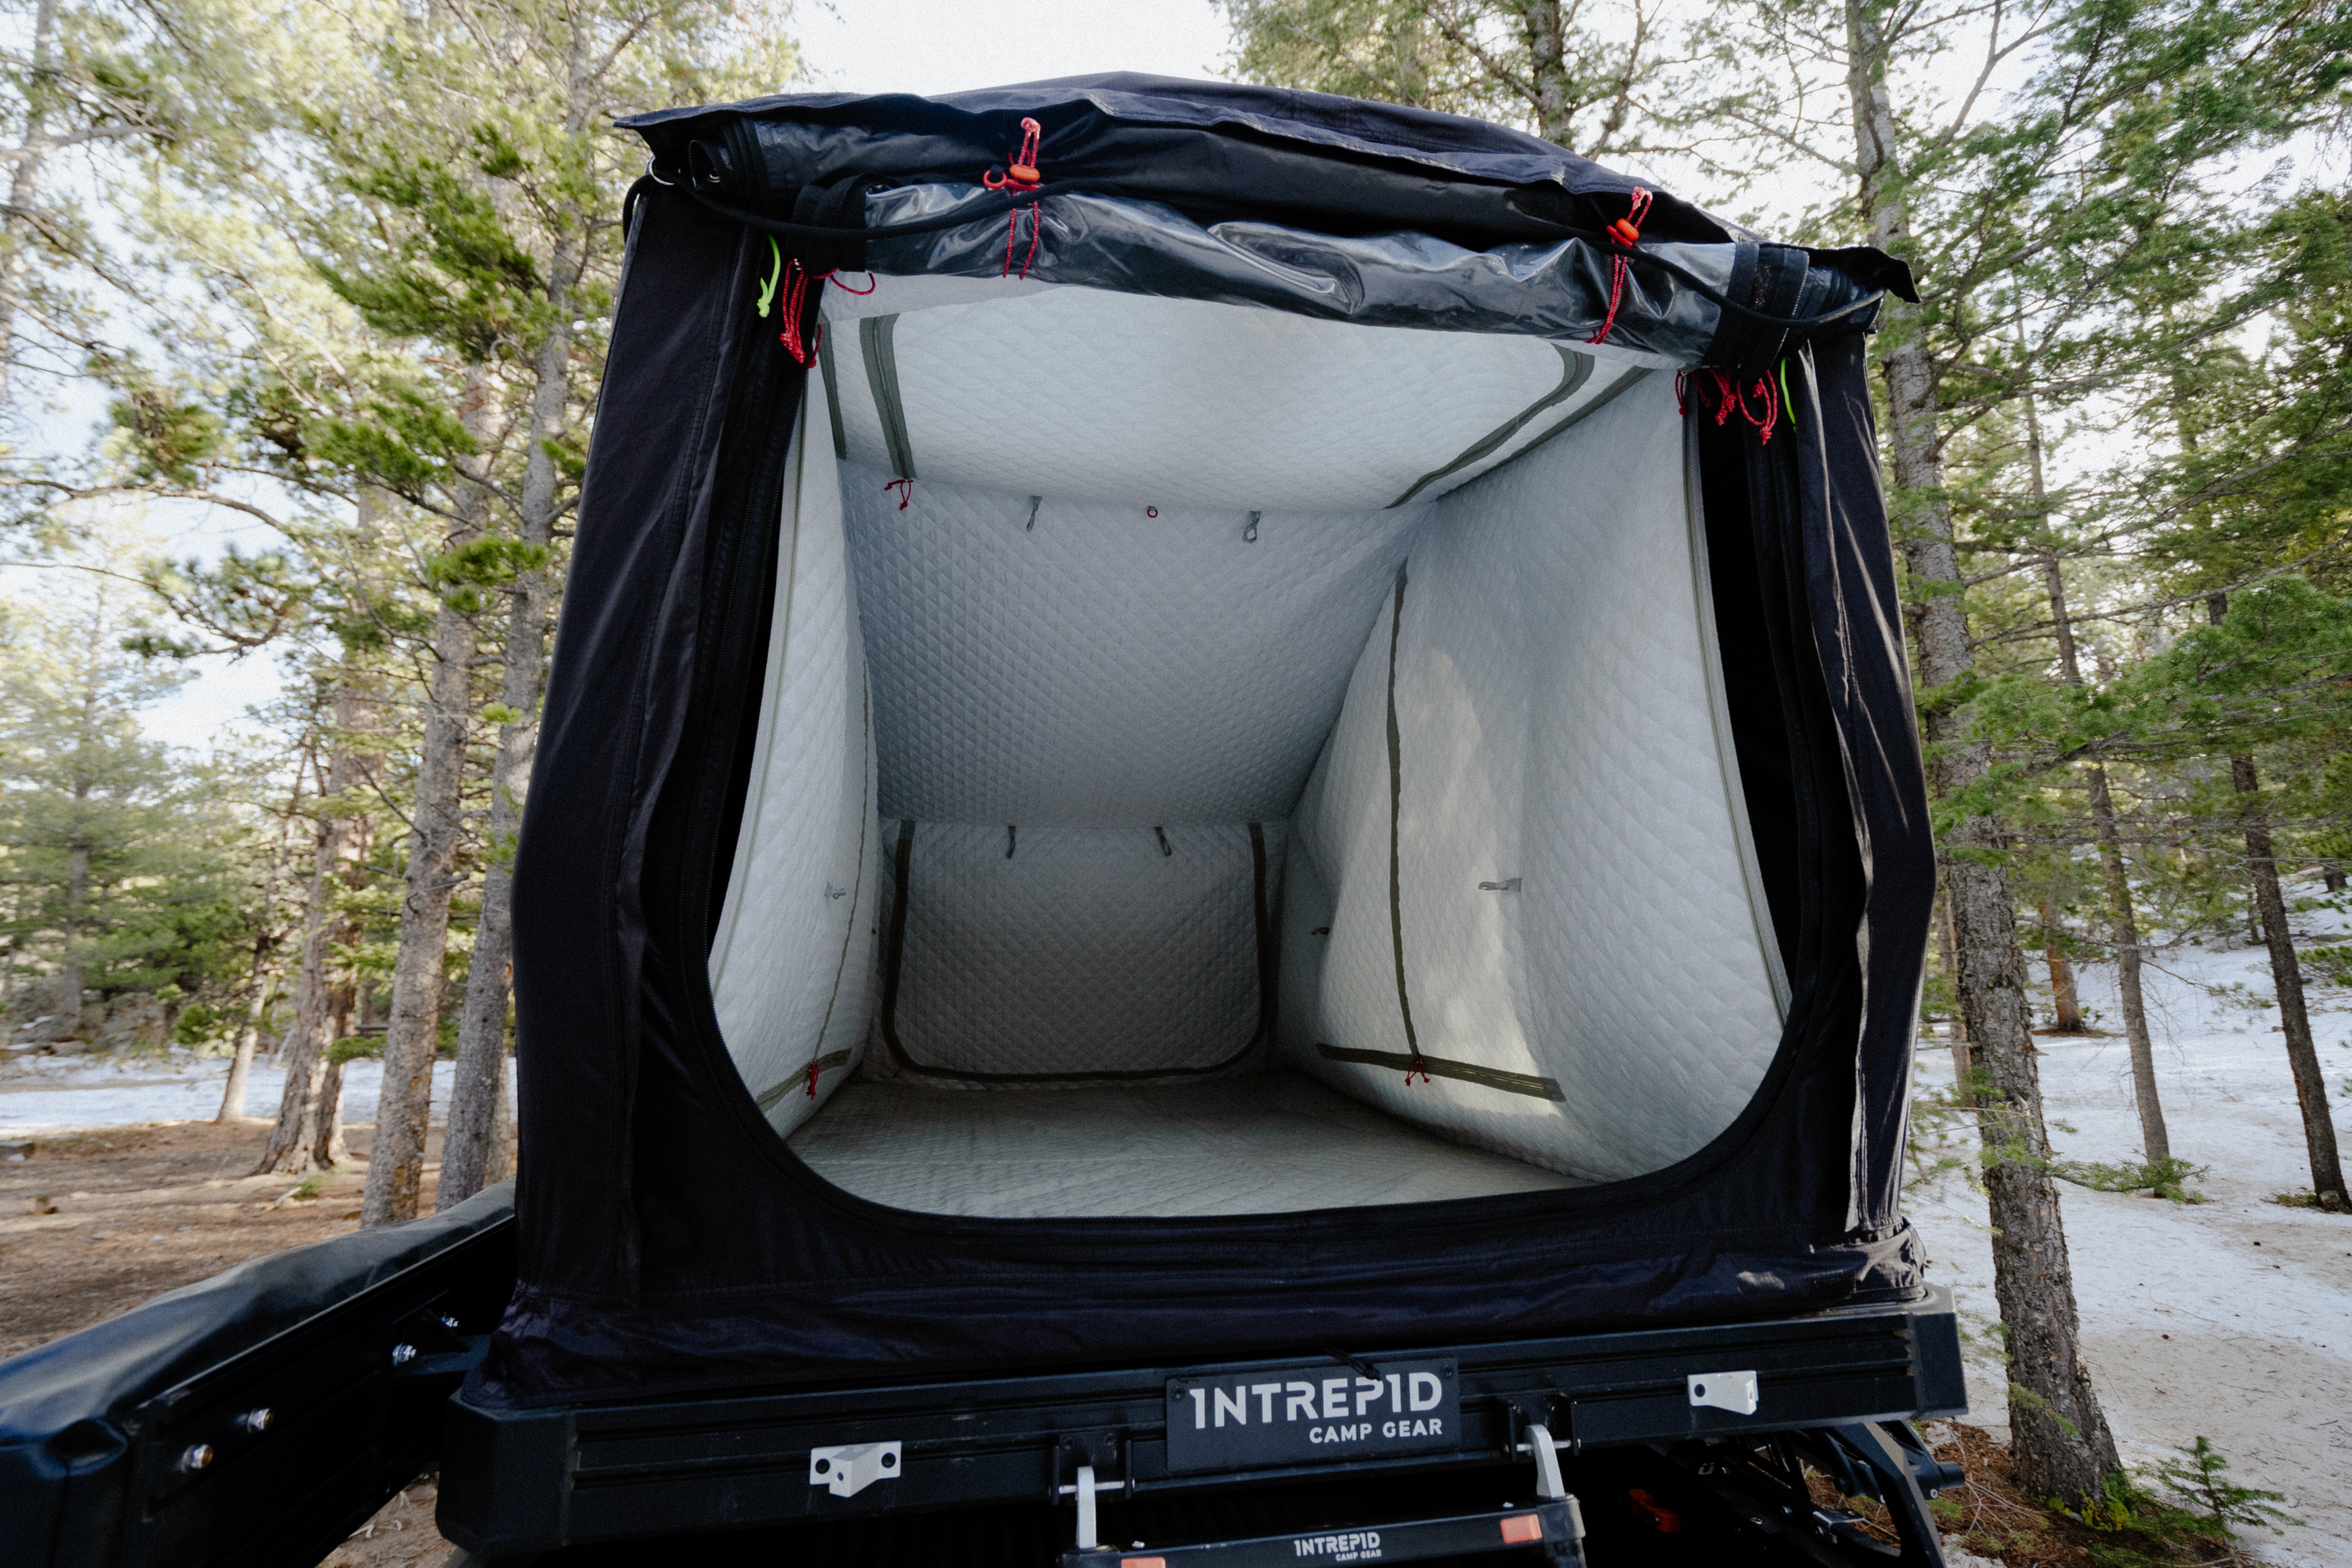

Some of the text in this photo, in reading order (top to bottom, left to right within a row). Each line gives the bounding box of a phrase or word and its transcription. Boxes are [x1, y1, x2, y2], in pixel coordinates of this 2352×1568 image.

[1189, 1371, 1443, 1430] INTREPID
[1309, 1418, 1443, 1444] CAMP GEAR
[1293, 1531, 1381, 1557] INTREPID
[1335, 1548, 1382, 1562] CAMP GEAR
